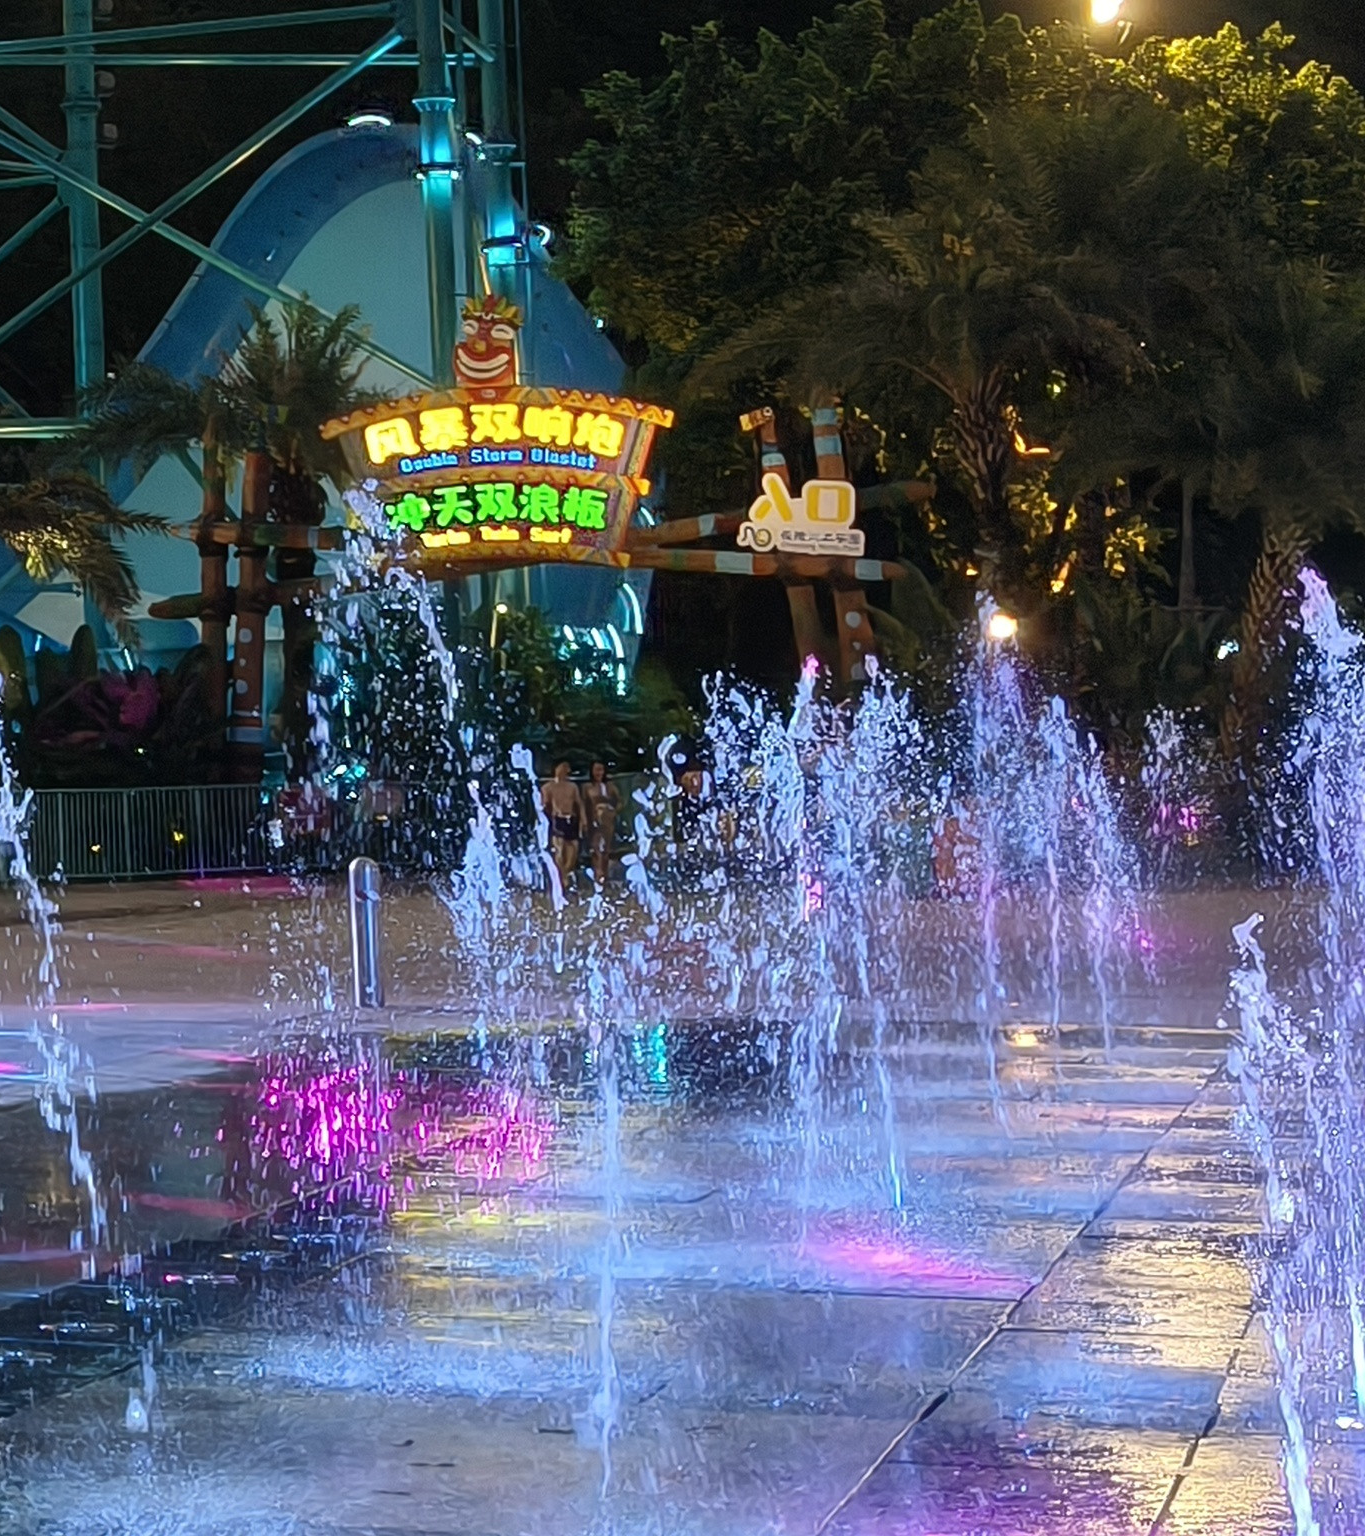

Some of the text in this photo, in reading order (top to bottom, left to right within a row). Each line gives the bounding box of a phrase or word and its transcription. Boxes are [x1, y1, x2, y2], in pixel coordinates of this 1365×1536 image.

[365, 403, 625, 464] 风暴双响炮
[470, 448, 524, 464] Storm
[385, 482, 609, 531] 冲天双浪板
[754, 477, 850, 523] 入口
